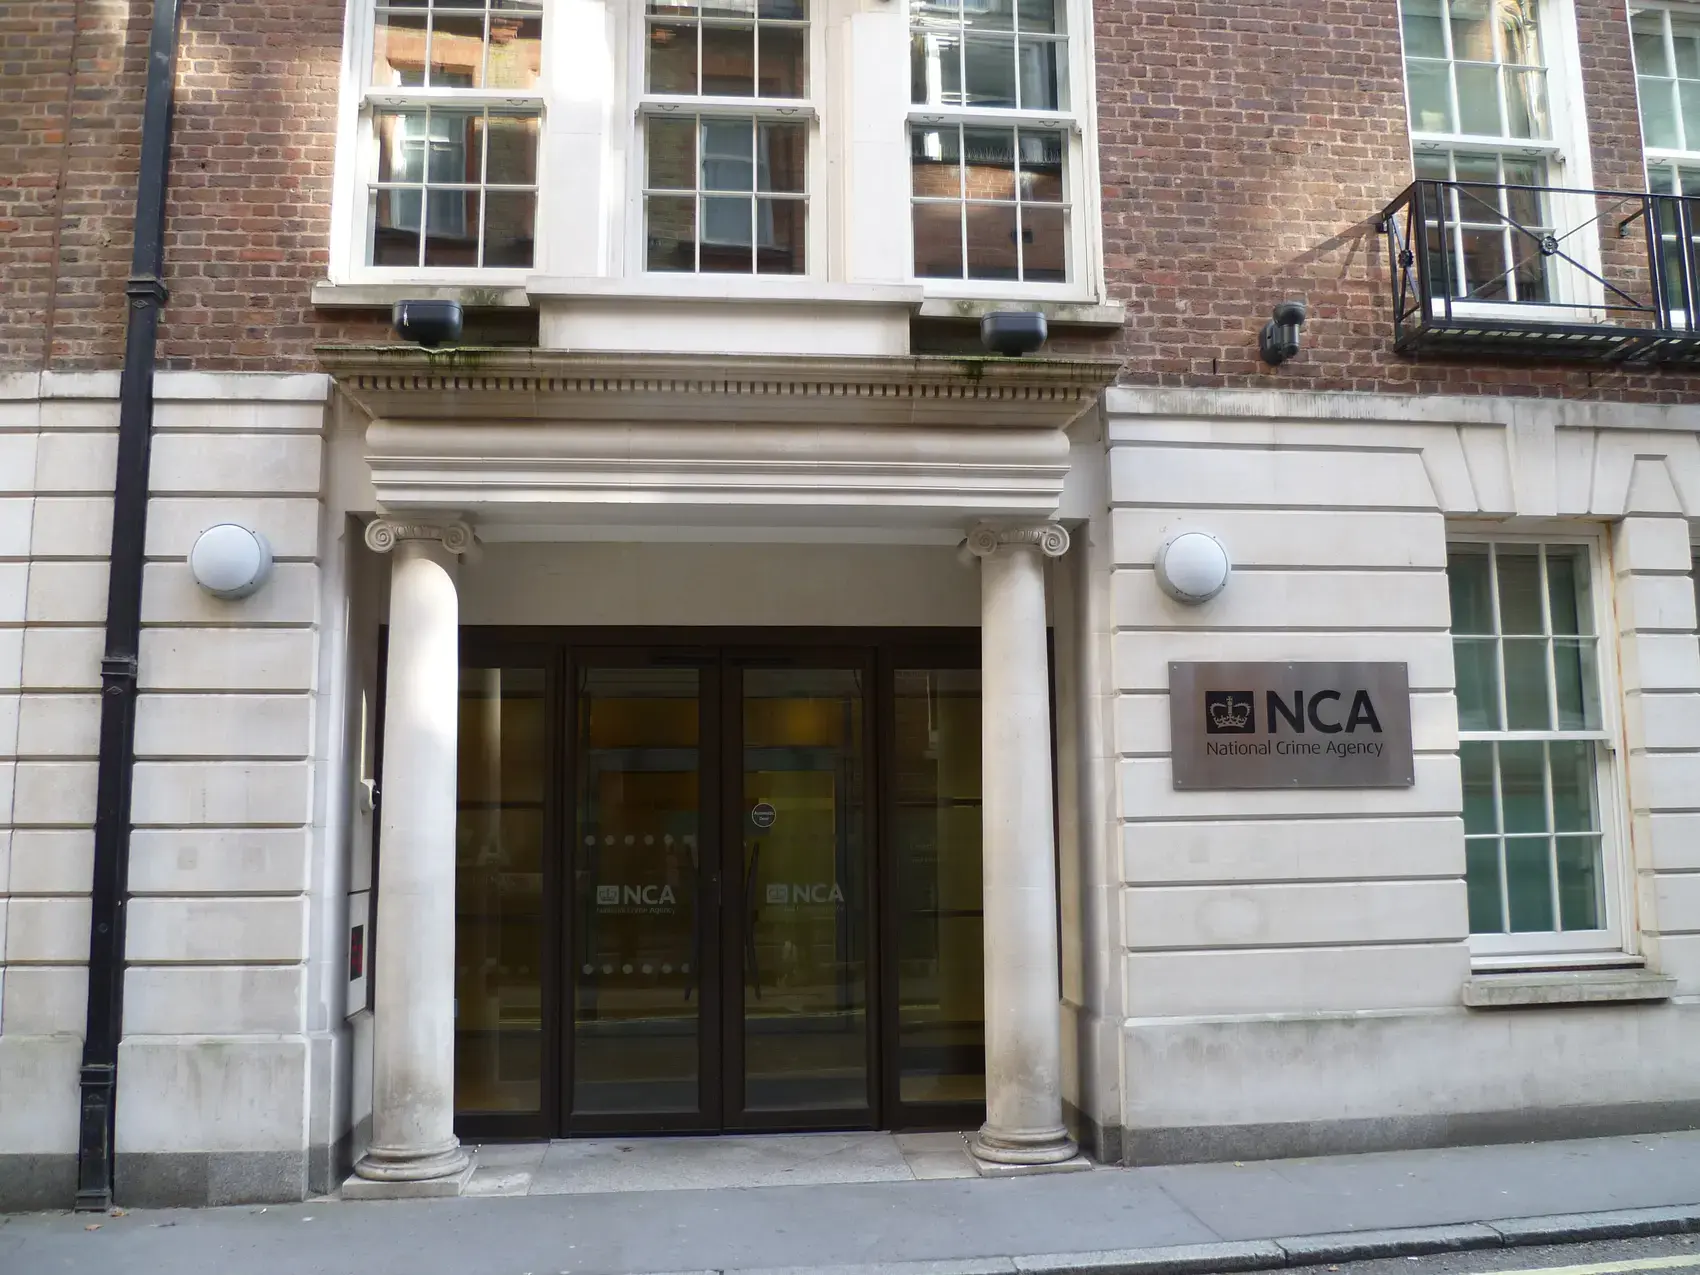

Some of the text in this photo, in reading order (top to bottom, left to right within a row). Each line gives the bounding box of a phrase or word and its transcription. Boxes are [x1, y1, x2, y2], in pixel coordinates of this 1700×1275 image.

[1266, 689, 1383, 734] NCA
[1206, 740, 1383, 758] National Crime Agency
[624, 884, 676, 905] NCA
[793, 883, 844, 903] NCA
